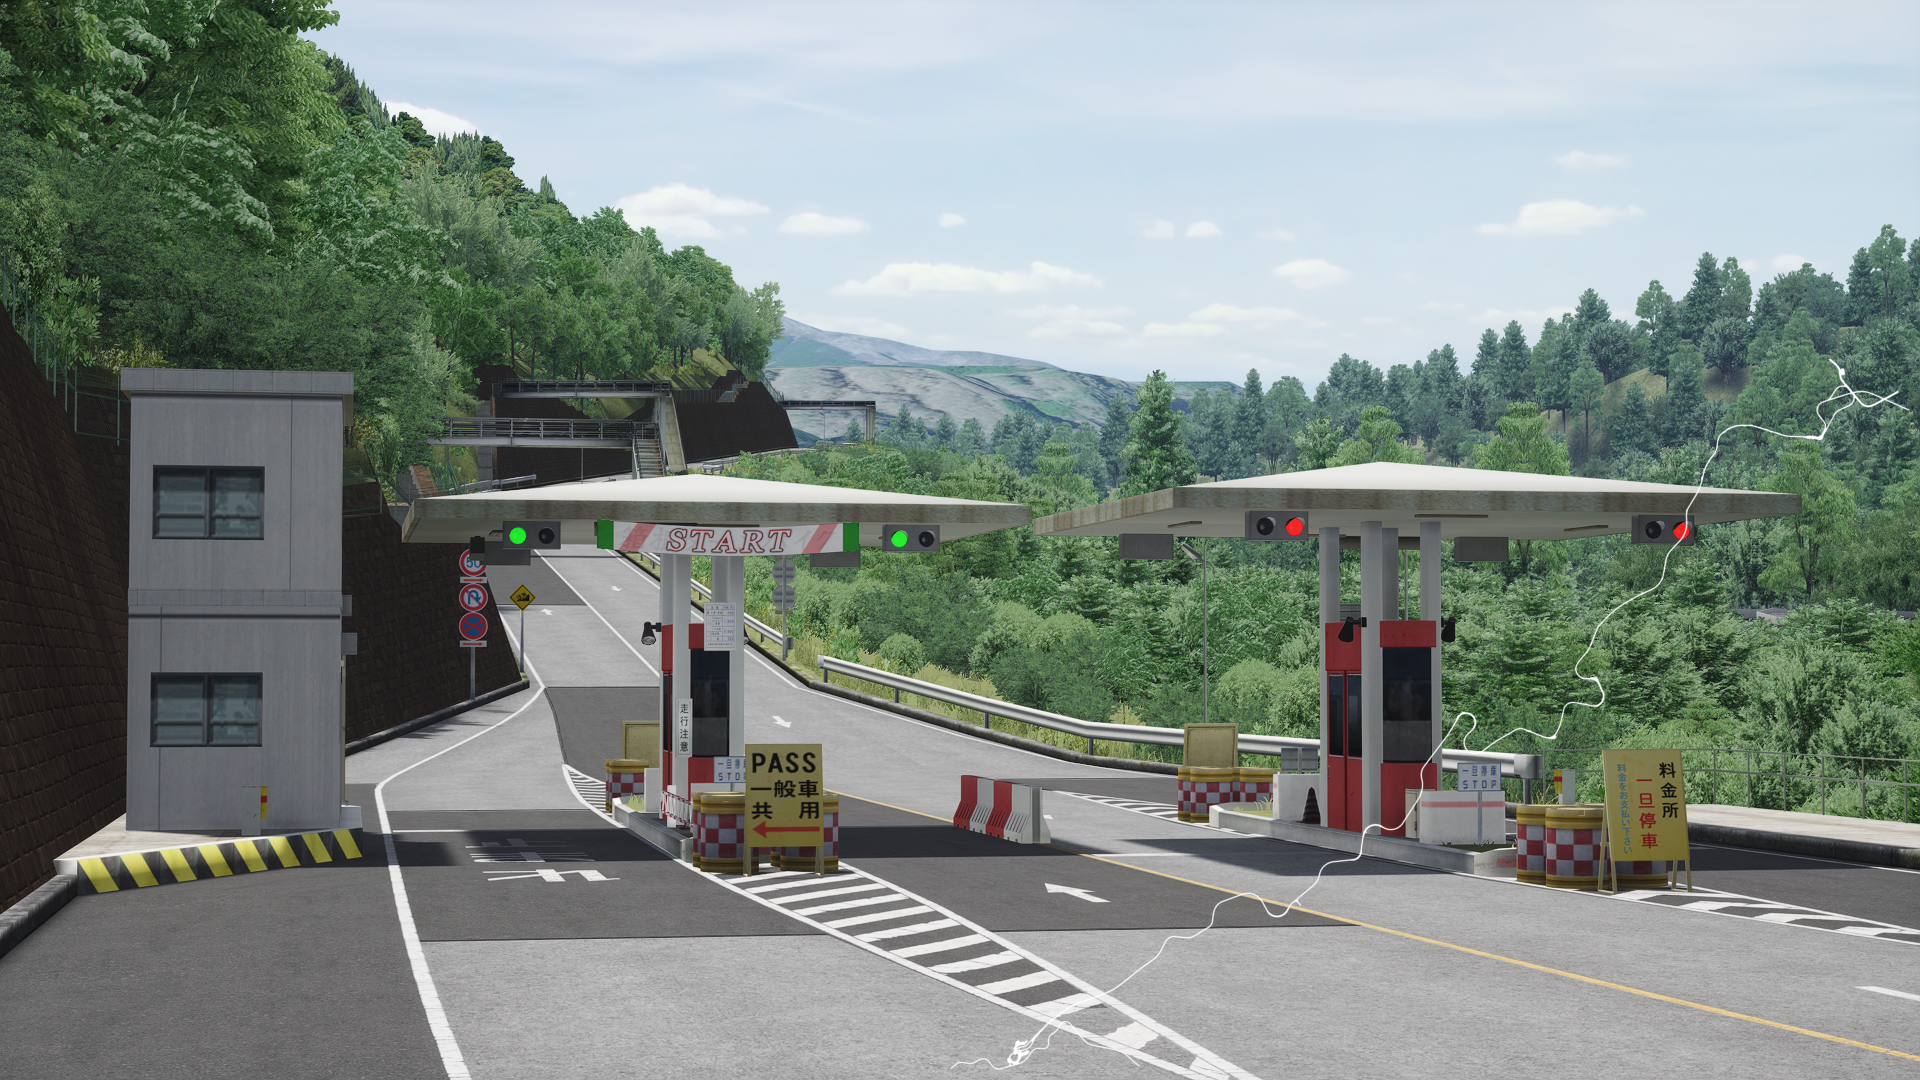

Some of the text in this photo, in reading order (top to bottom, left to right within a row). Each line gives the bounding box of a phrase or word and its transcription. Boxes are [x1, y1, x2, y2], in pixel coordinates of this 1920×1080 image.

[666, 528, 792, 554] START
[680, 703, 689, 752] 走行注意
[718, 759, 746, 769] 一旦停
[752, 752, 816, 773] PASS
[718, 772, 746, 781] STO
[1462, 780, 1497, 789] STOP
[750, 780, 819, 798] 一般車
[1659, 762, 1679, 818] 料金所
[1616, 764, 1633, 854] 料金をお支払い下さい
[1636, 778, 1658, 849] 一旦停車
